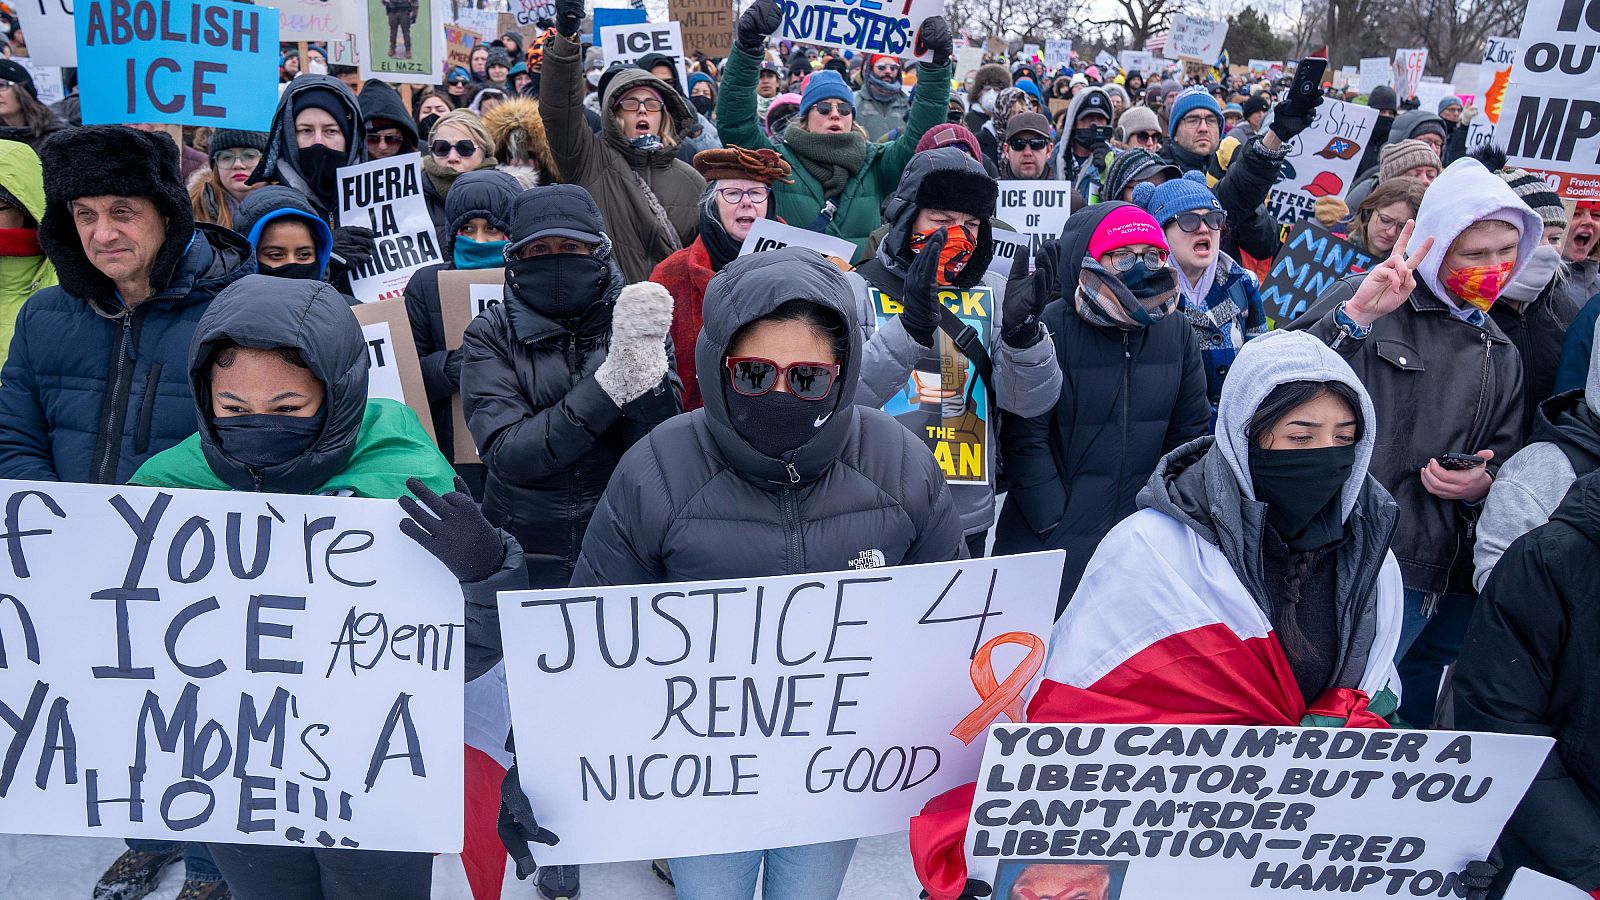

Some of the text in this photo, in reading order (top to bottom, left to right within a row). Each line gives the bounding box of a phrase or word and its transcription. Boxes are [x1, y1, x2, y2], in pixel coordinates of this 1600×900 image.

[86, 0, 259, 53] ABOLISH
[517, 4, 557, 24] GOOD
[616, 30, 672, 55] ICE
[1524, 42, 1600, 75] OU
[381, 62, 423, 72] EL NAZI
[126, 57, 228, 118] ICE
[1325, 101, 1367, 140] Shit
[1471, 124, 1495, 147] Tod
[1507, 95, 1600, 164] MP
[342, 163, 419, 212] FUERA
[1566, 187, 1600, 197] Socialis
[1570, 177, 1600, 187] Freedo
[1001, 190, 1066, 208] ICE OUT
[368, 203, 399, 239] LA
[1026, 213, 1041, 227] OF
[926, 426, 955, 439] THE
[933, 441, 981, 477] AN
[848, 556, 873, 567] NORTH
[856, 562, 874, 570] FACE
[859, 550, 873, 558] THE
[90, 588, 306, 679] ICE
[522, 569, 1003, 673] JUSTICE 4
[652, 672, 870, 740] RENEE
[365, 692, 426, 793] A
[993, 726, 1105, 756] YOU
[1114, 726, 1228, 757] CAN
[1435, 735, 1472, 764] A
[580, 745, 941, 801] NICOLE GOOD
[1391, 771, 1493, 803] YOU
[86, 766, 359, 848] HOE!!!
[973, 799, 1132, 828] CAN'T
